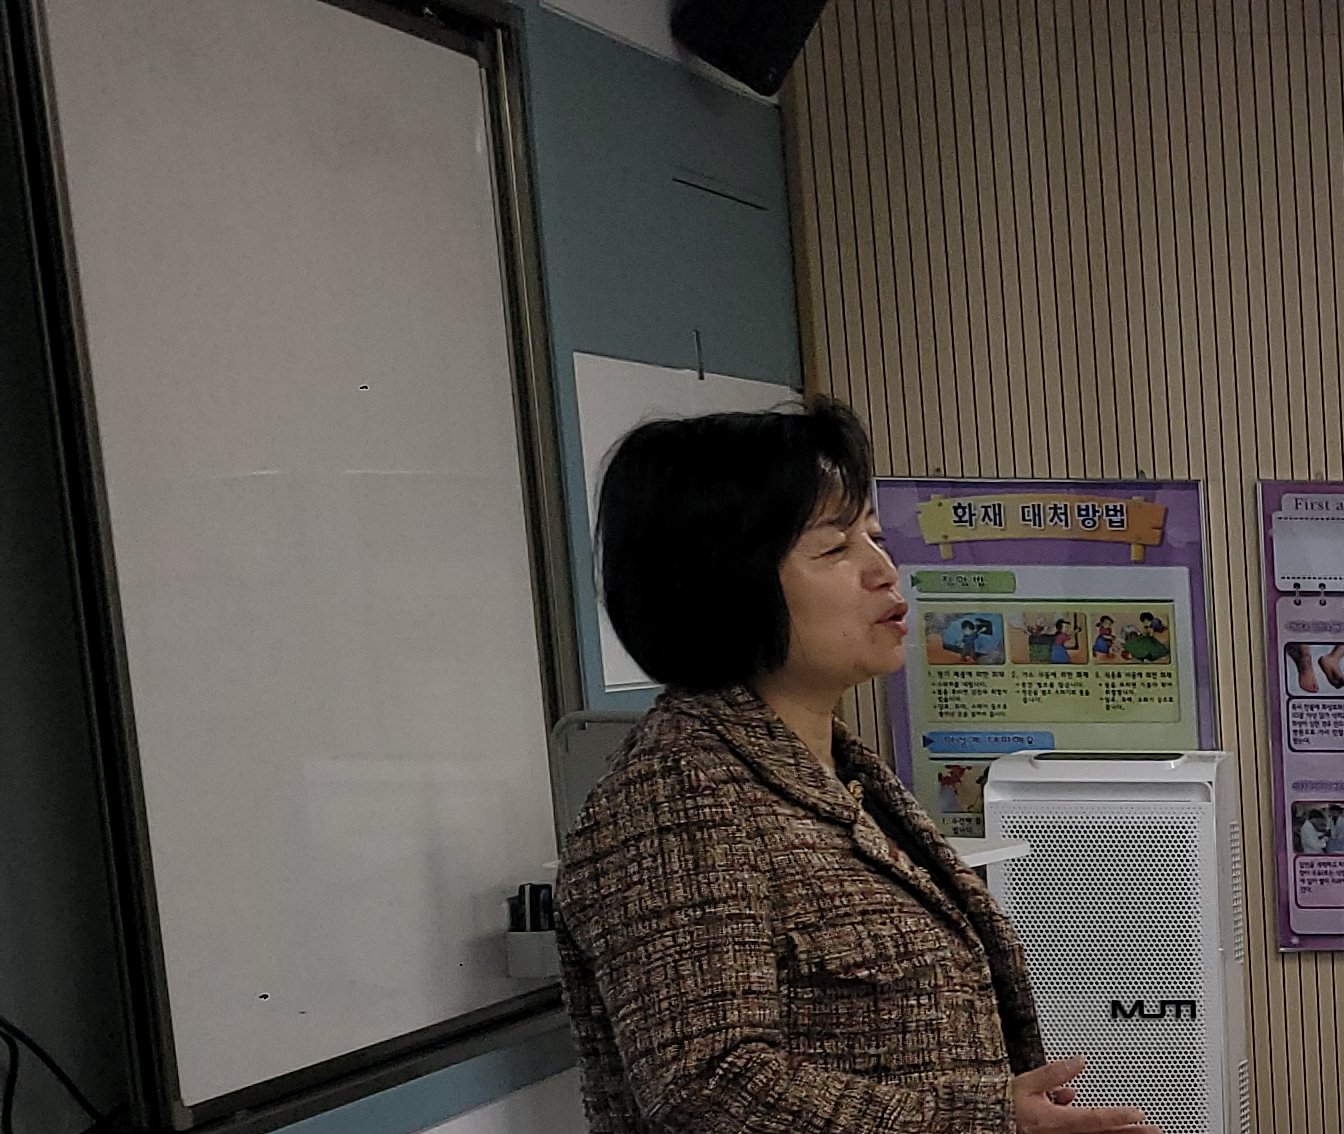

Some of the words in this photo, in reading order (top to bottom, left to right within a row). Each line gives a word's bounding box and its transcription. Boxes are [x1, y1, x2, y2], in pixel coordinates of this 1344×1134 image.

[1293, 497, 1331, 512] First
[952, 502, 1004, 529] 화재
[1020, 502, 1128, 530] 대처방법
